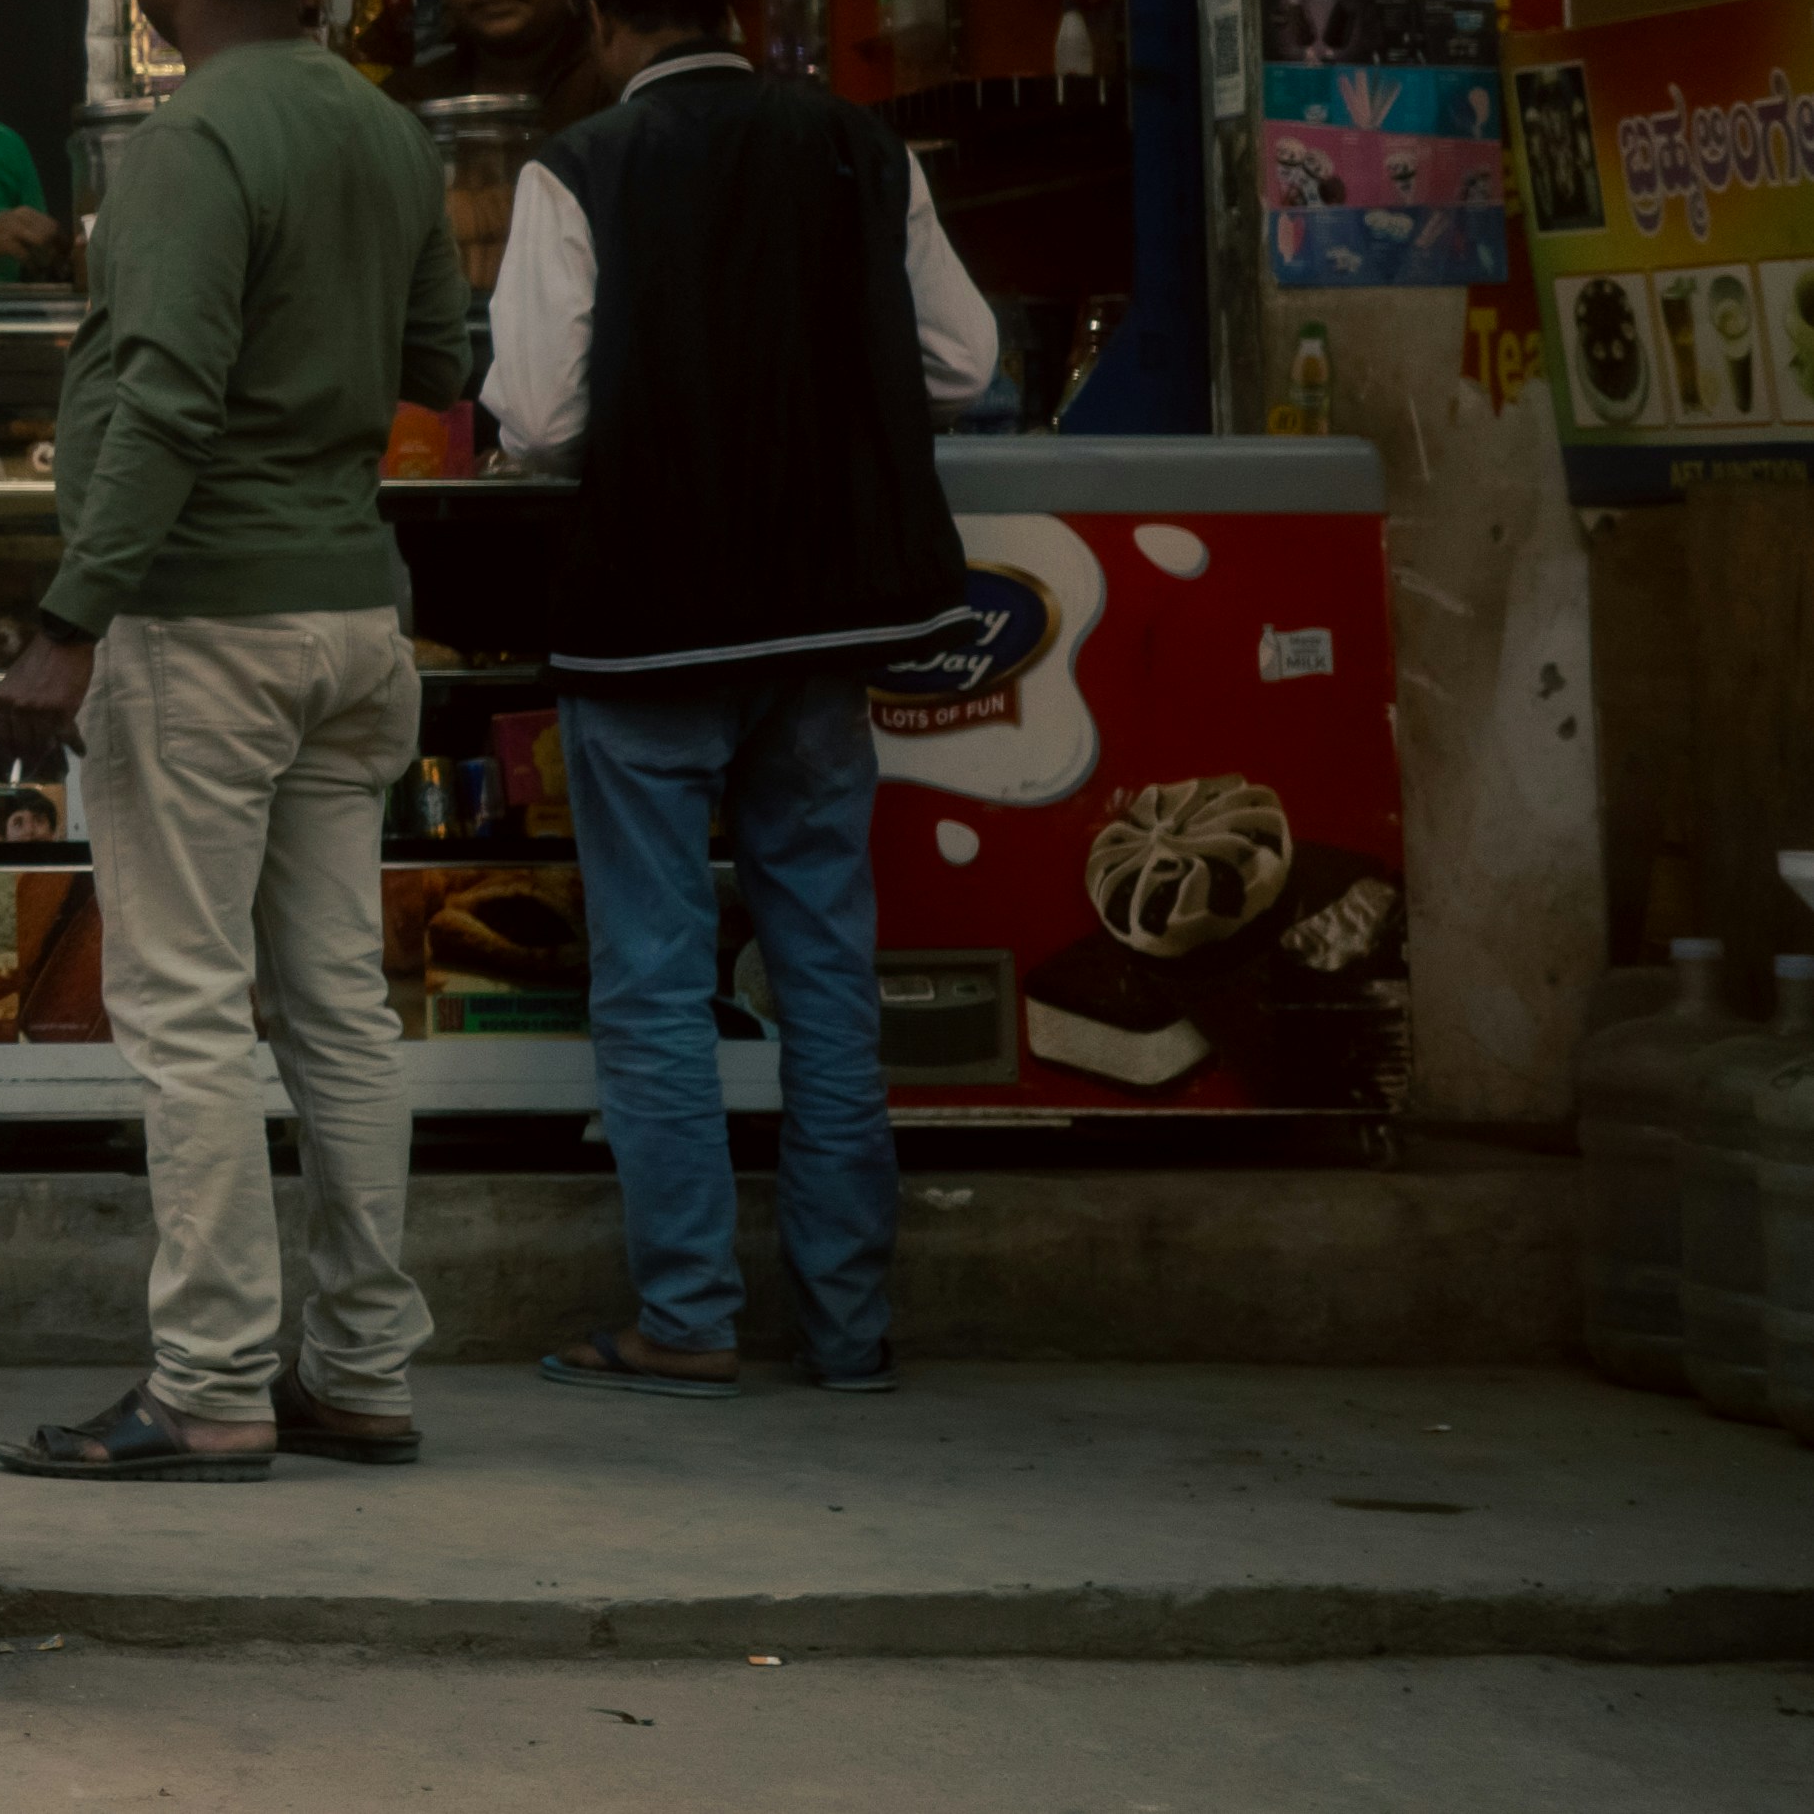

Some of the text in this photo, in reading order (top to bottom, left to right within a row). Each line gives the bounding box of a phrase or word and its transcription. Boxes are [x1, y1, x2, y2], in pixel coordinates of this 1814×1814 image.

[881, 693, 1007, 730] LOTS OF FUN
